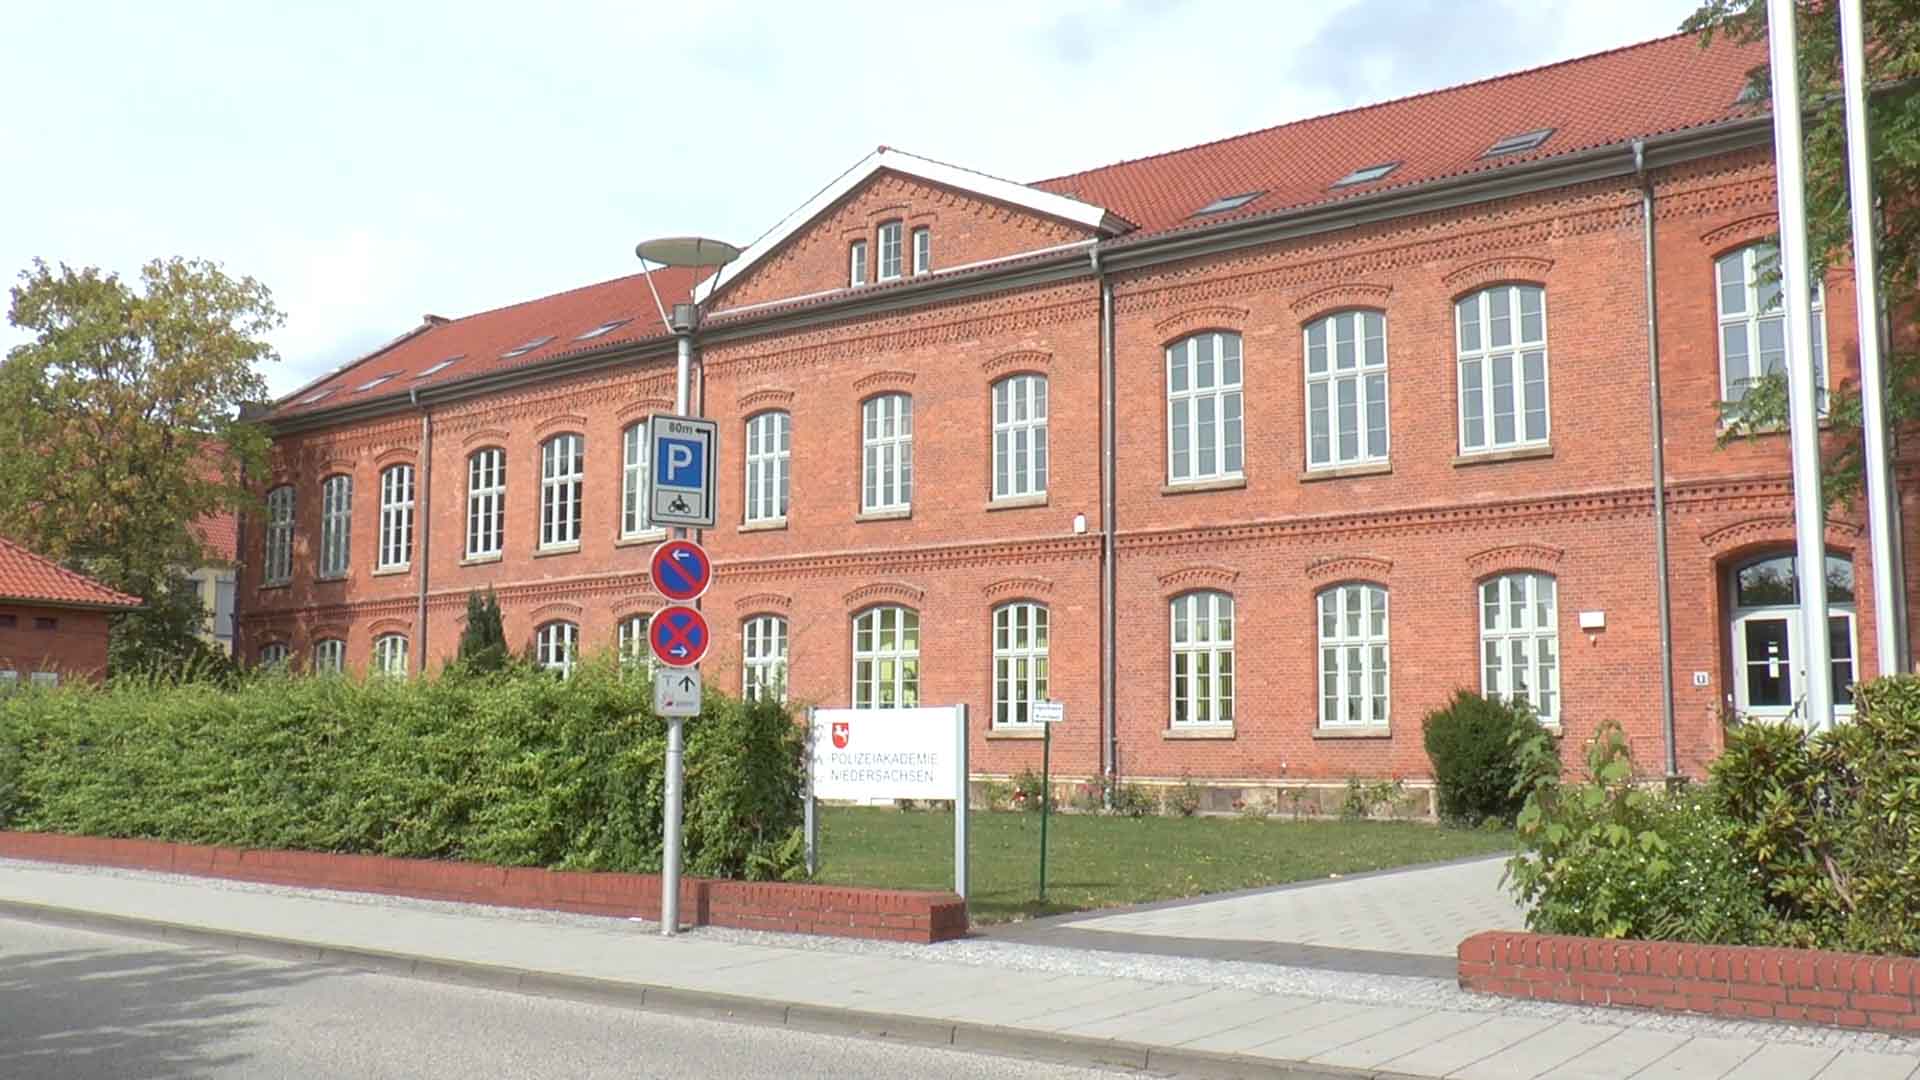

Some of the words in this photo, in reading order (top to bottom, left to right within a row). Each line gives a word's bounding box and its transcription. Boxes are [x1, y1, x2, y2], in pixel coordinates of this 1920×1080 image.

[668, 422, 693, 434] 80m
[667, 443, 693, 481] P
[831, 752, 938, 766] POLIZEIAKADEMIE
[831, 769, 934, 783] NIEDERSACHSEN
